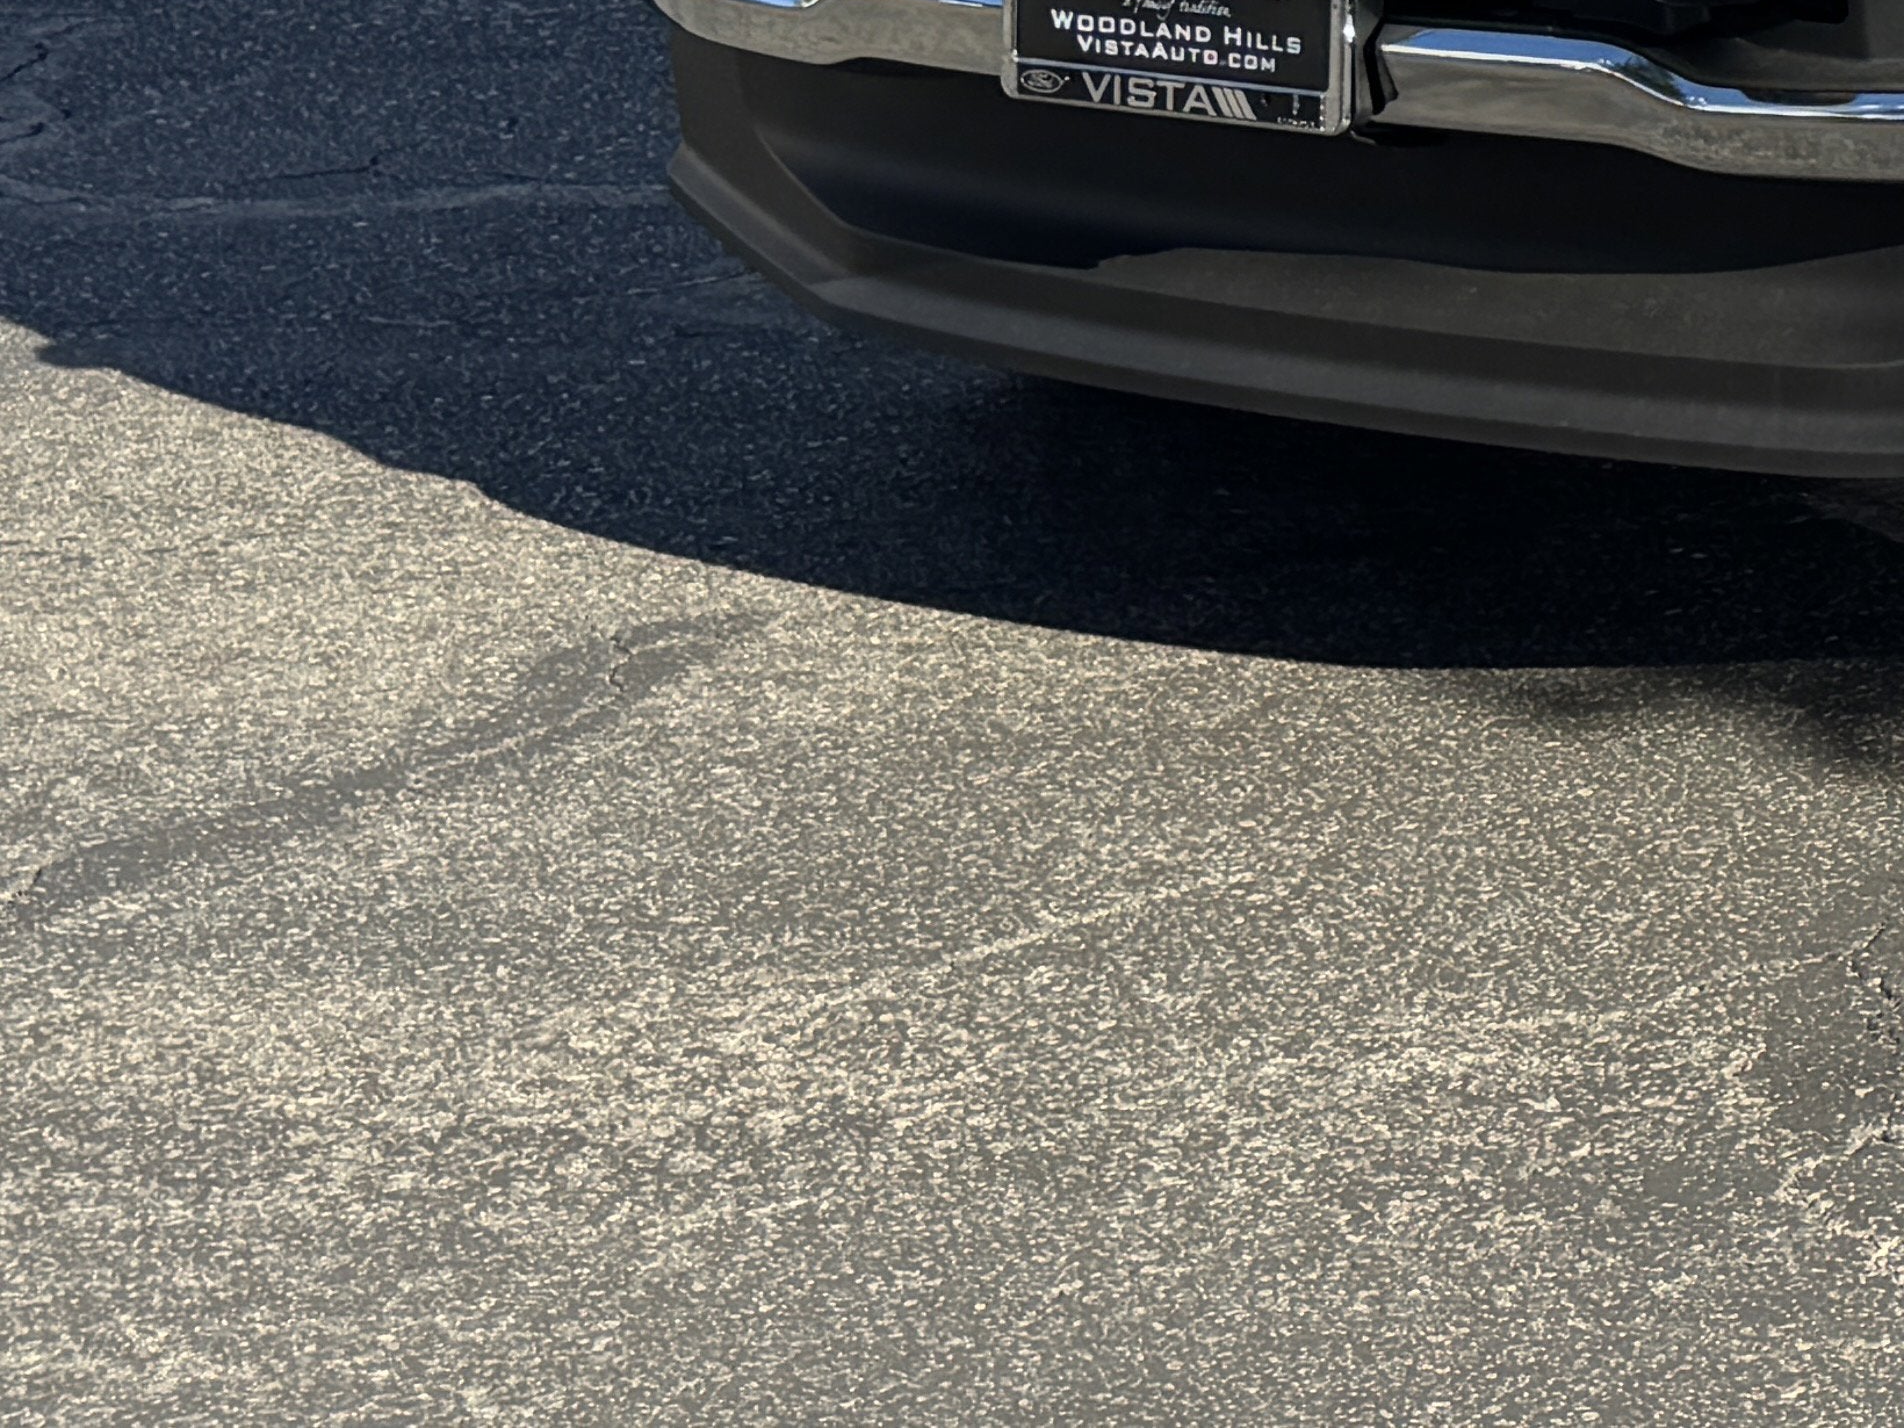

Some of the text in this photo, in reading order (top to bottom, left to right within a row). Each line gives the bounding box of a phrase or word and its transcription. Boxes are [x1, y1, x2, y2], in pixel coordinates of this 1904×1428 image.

[1050, 8, 1302, 55] WOODLAND HILLS
[1081, 71, 1218, 117] VISTA
